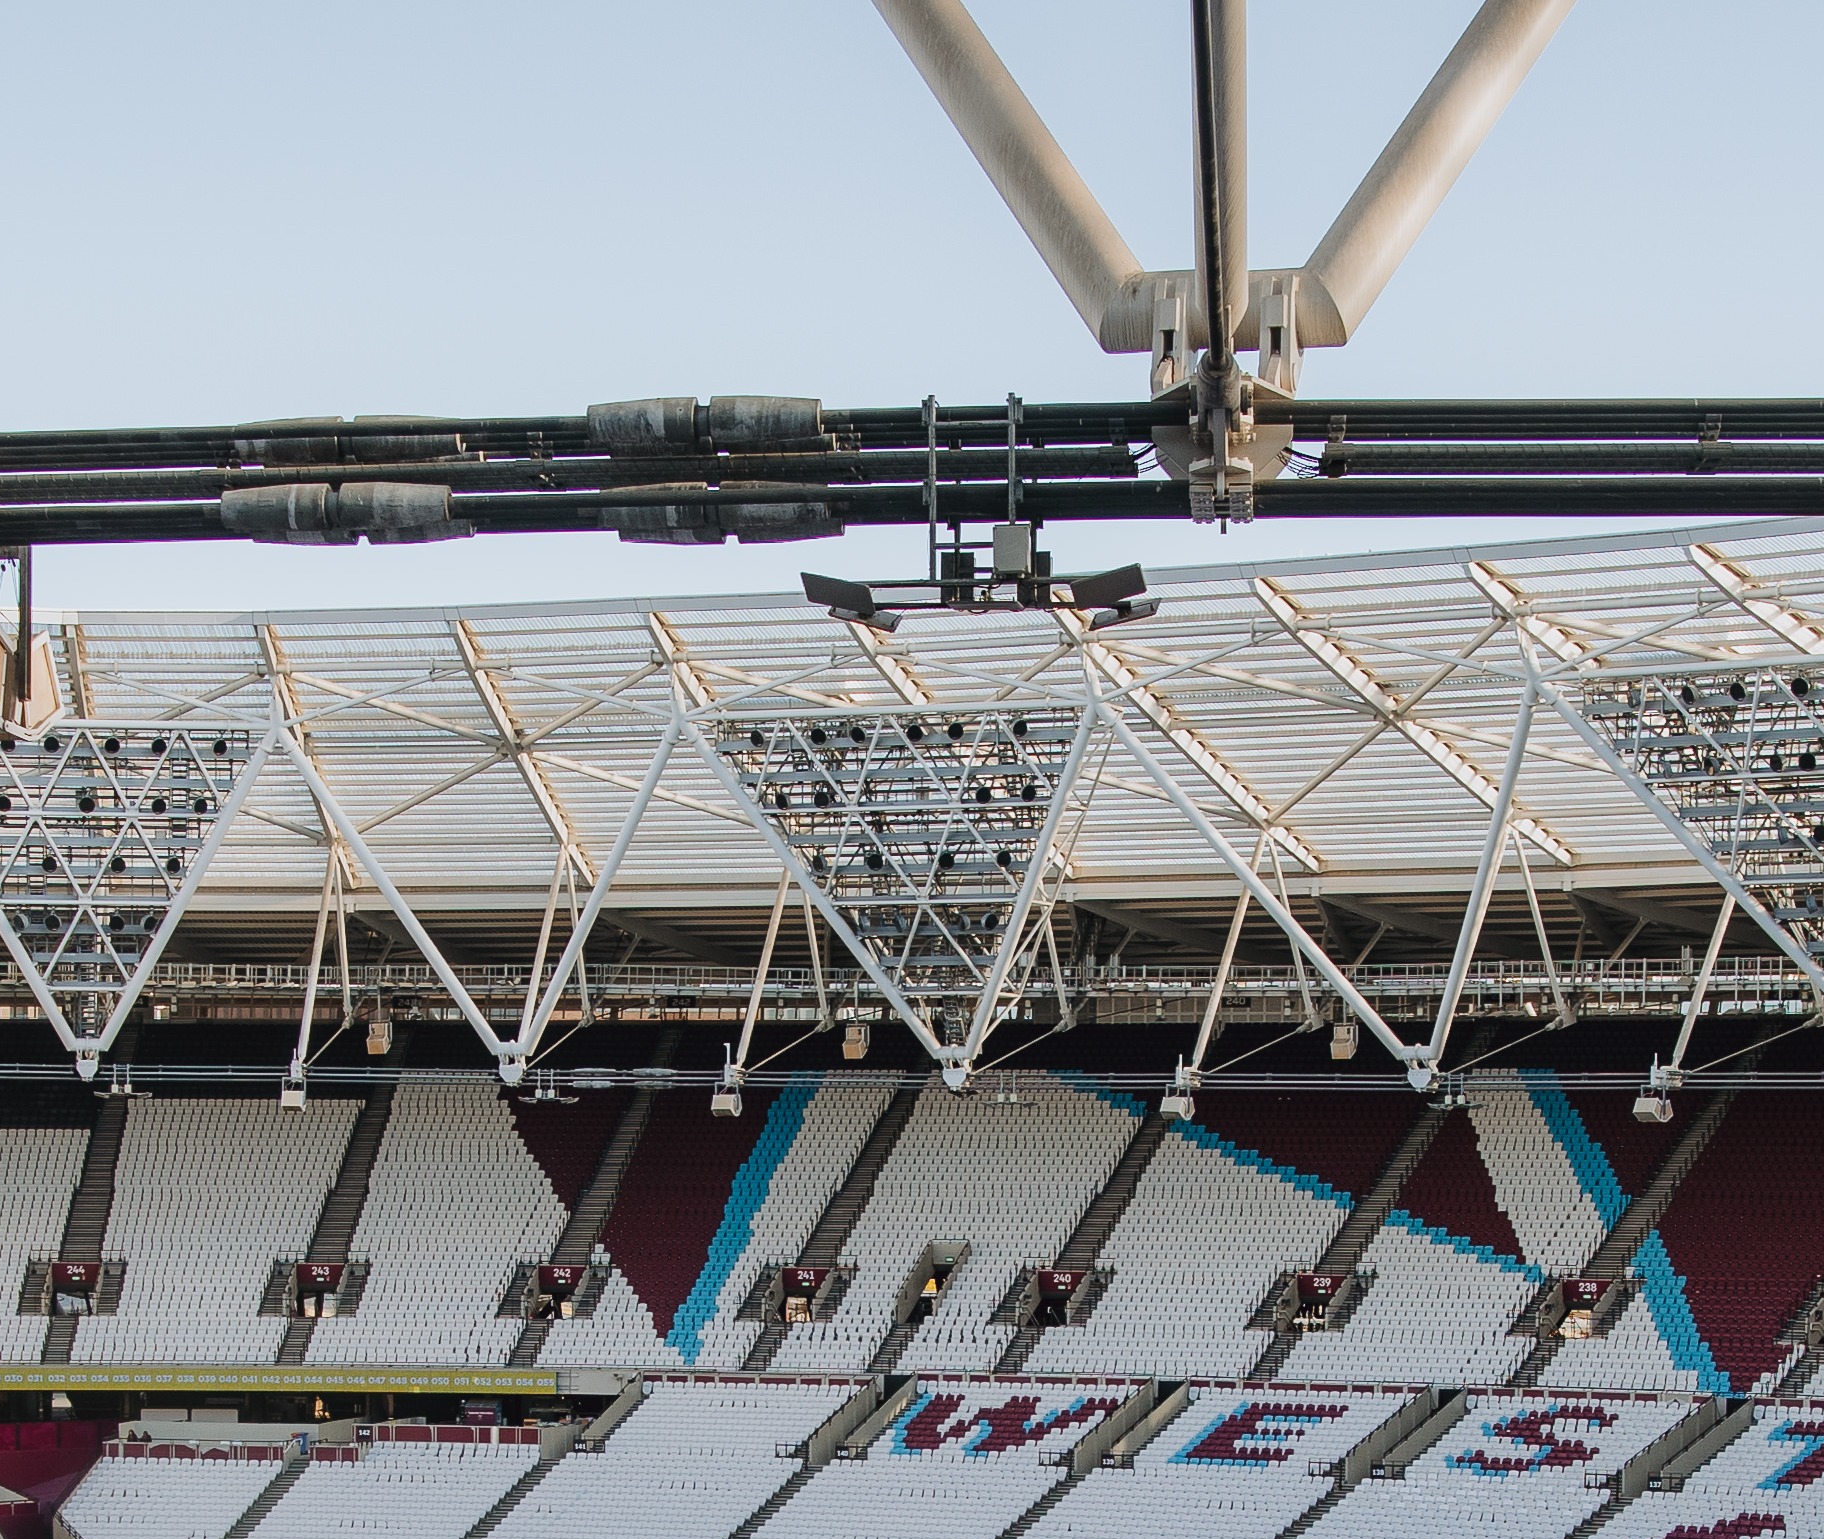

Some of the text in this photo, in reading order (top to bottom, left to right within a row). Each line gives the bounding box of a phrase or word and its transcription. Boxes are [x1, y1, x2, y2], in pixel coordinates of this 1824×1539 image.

[1226, 997, 1246, 1006] 240
[67, 1266, 85, 1274] 244
[312, 1267, 329, 1275] 243
[554, 1268, 570, 1277] 242
[798, 1271, 814, 1279] 241
[1054, 1274, 1071, 1283] 240
[1314, 1278, 1331, 1286] 239
[1579, 1283, 1597, 1292] 238
